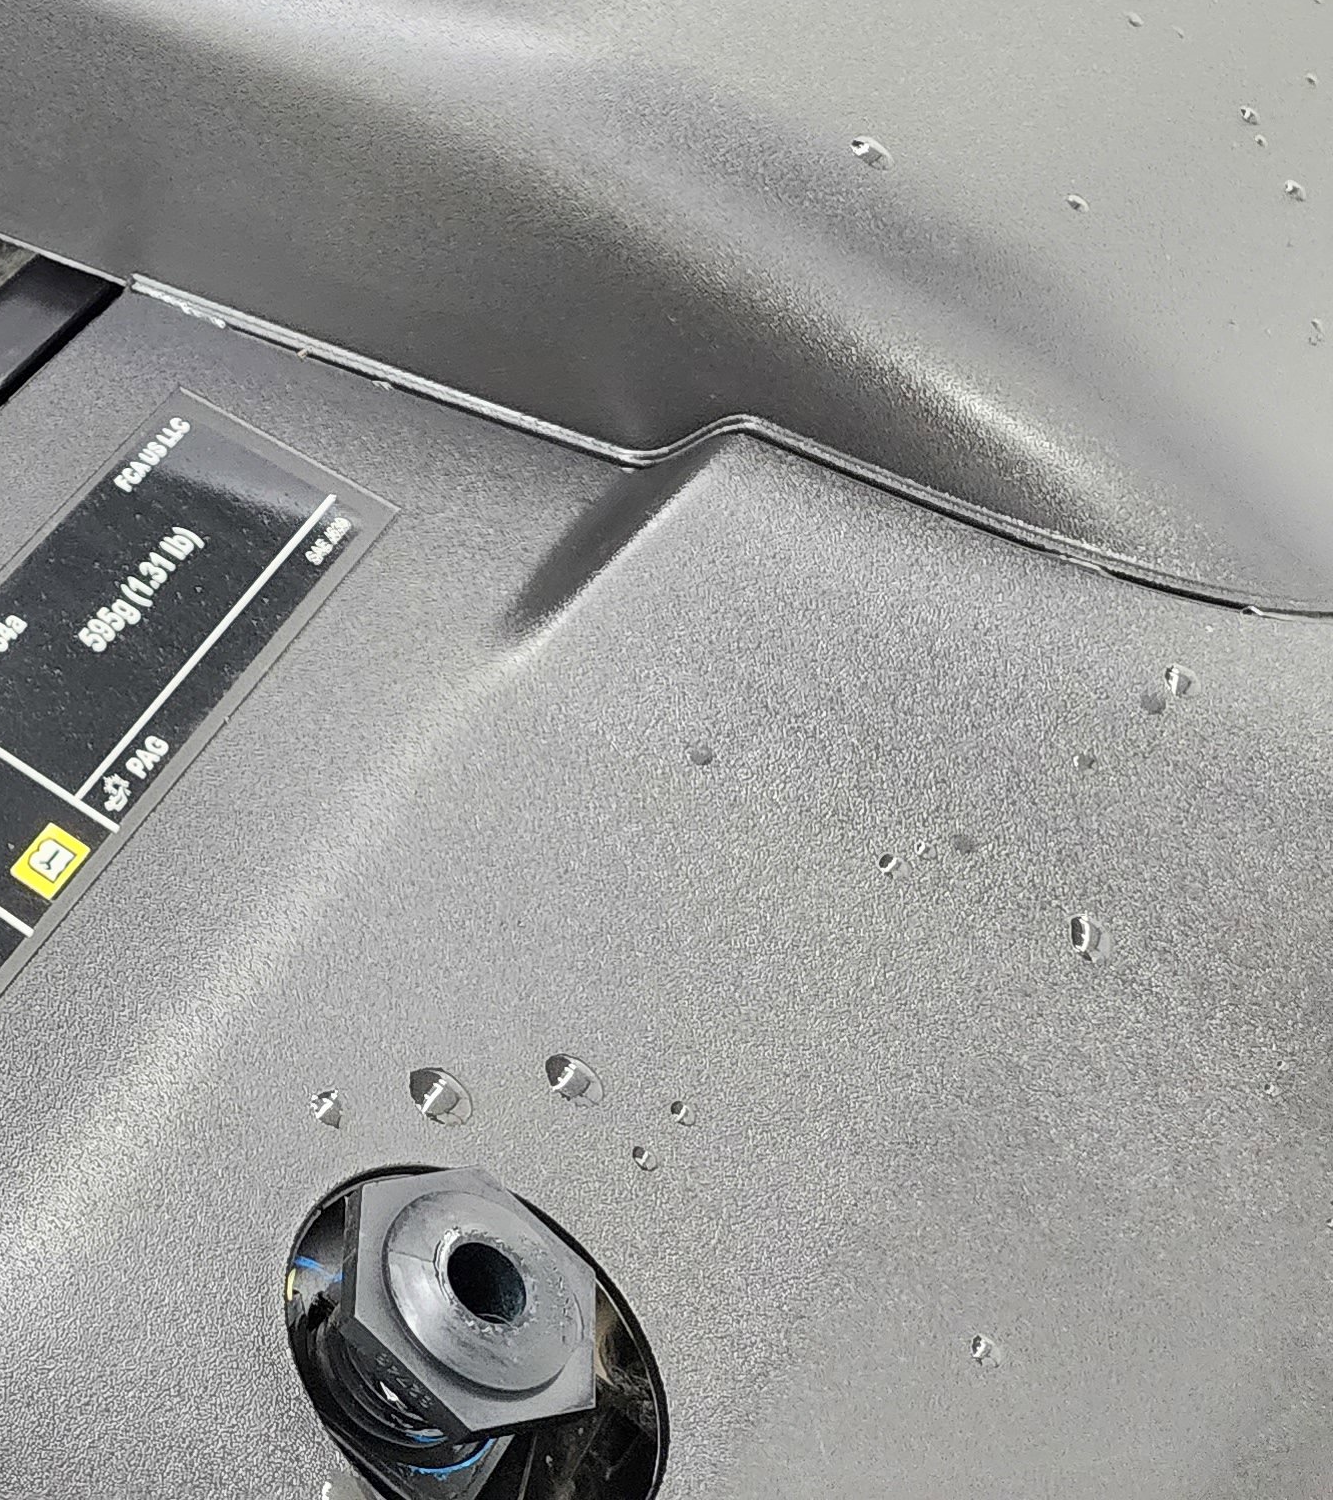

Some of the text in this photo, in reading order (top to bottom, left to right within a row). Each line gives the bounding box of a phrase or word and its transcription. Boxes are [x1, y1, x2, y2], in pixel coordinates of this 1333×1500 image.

[113, 417, 191, 493] FCA US LLC
[77, 526, 205, 653] 595g (1.31 lb)
[125, 734, 170, 780] PAG
